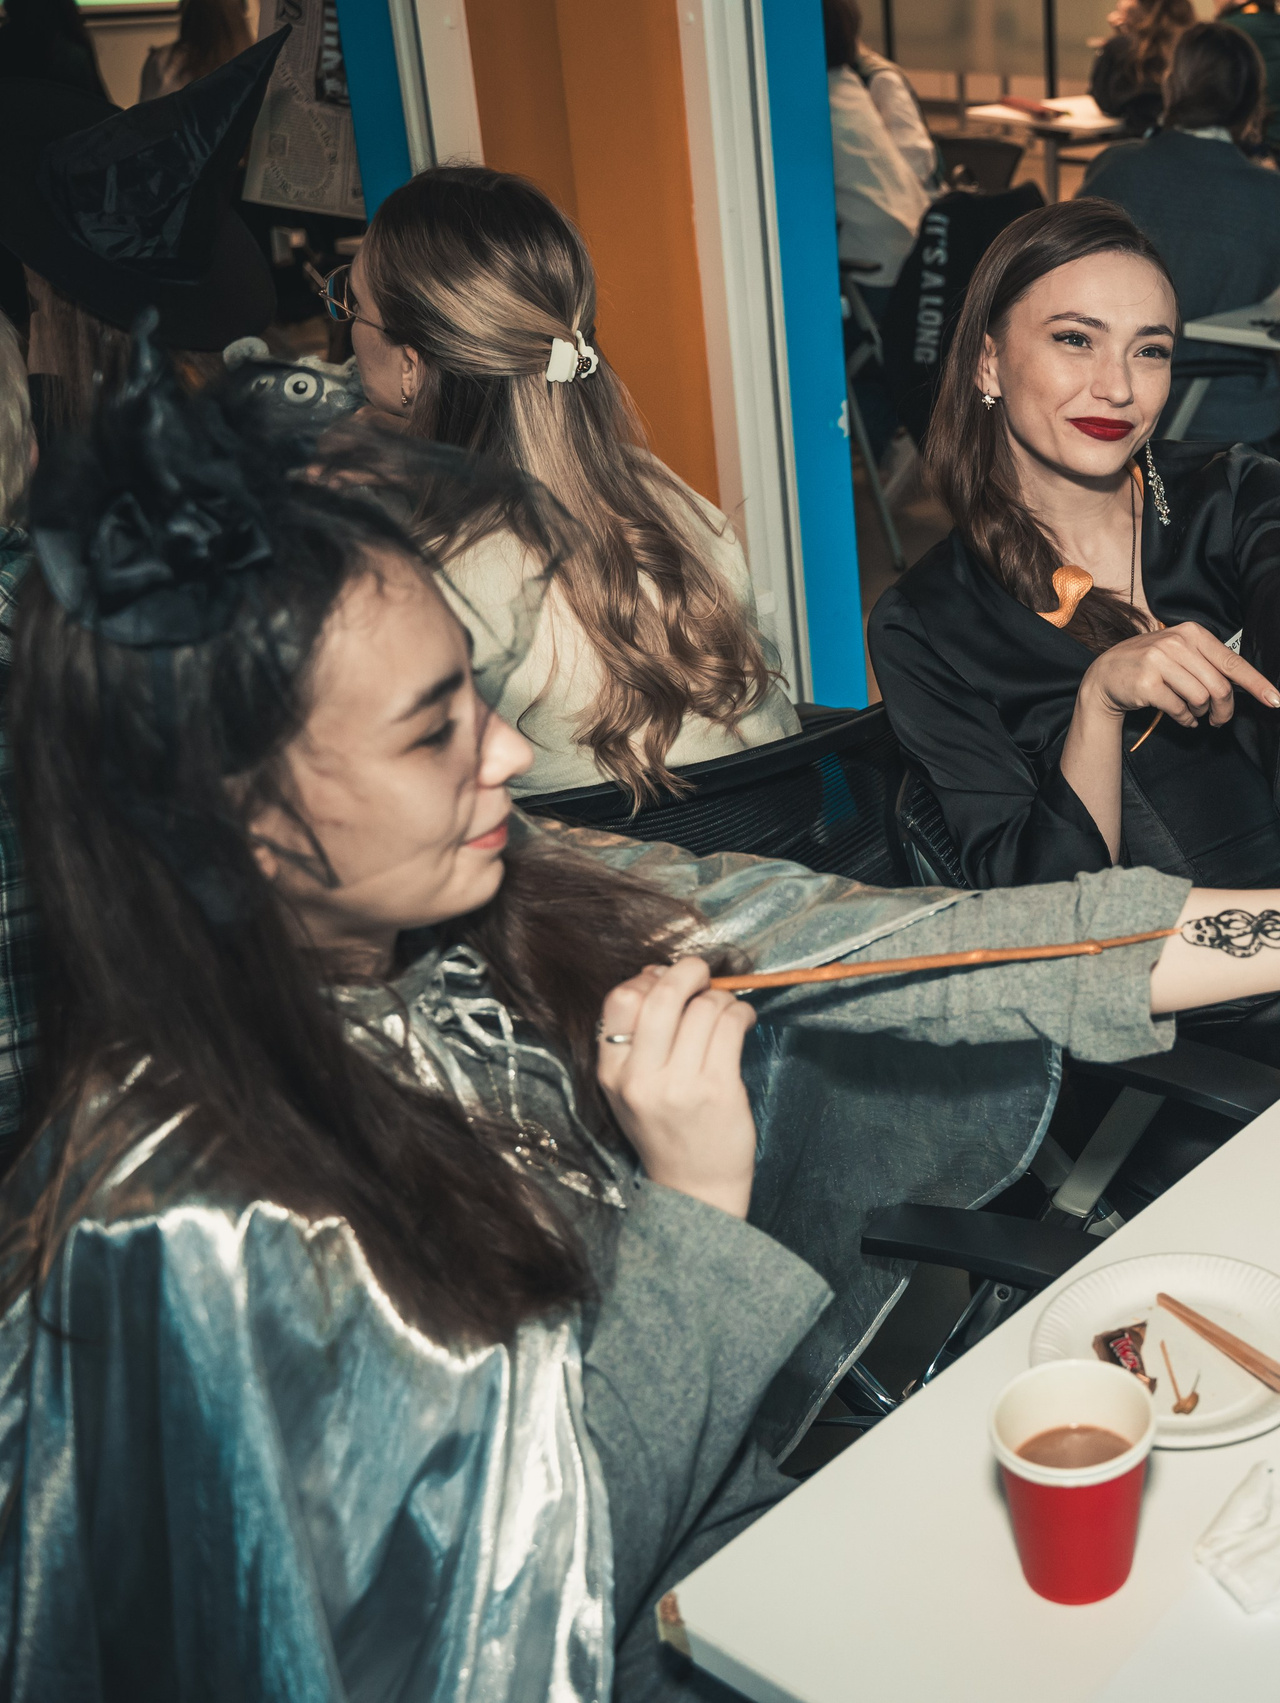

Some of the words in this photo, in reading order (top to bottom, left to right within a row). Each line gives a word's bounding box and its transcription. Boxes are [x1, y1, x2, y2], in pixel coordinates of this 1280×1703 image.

[922, 213, 950, 265] IT'S
[921, 271, 946, 289] A
[914, 295, 943, 363] LONG
